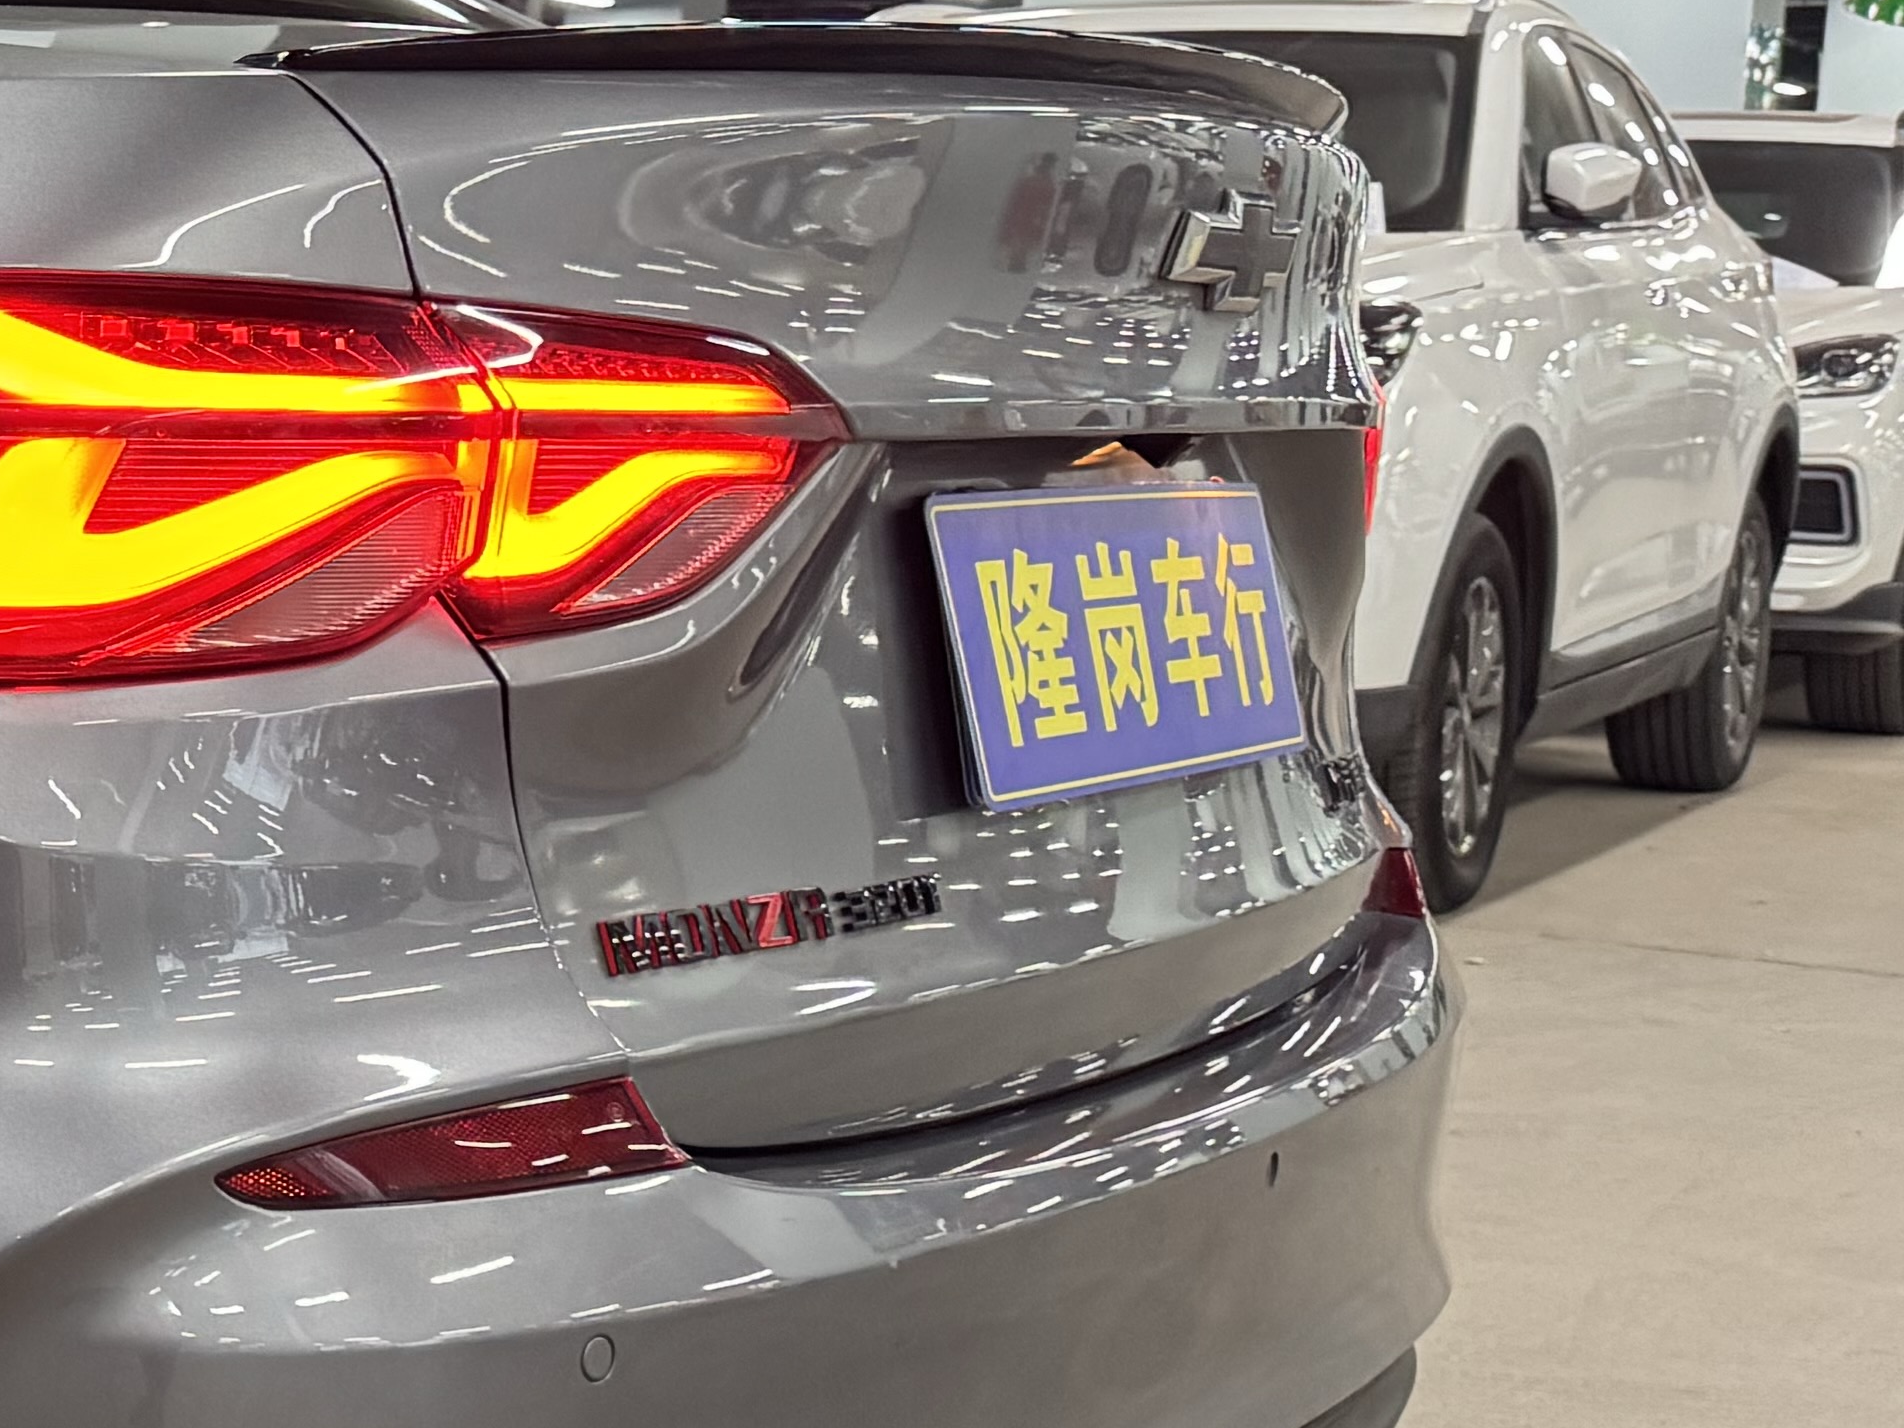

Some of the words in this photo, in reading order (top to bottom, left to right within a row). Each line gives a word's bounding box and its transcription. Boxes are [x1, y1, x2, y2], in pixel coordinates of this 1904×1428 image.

[975, 532, 1274, 748] 隆岗车行
[596, 886, 834, 976] MONZA
